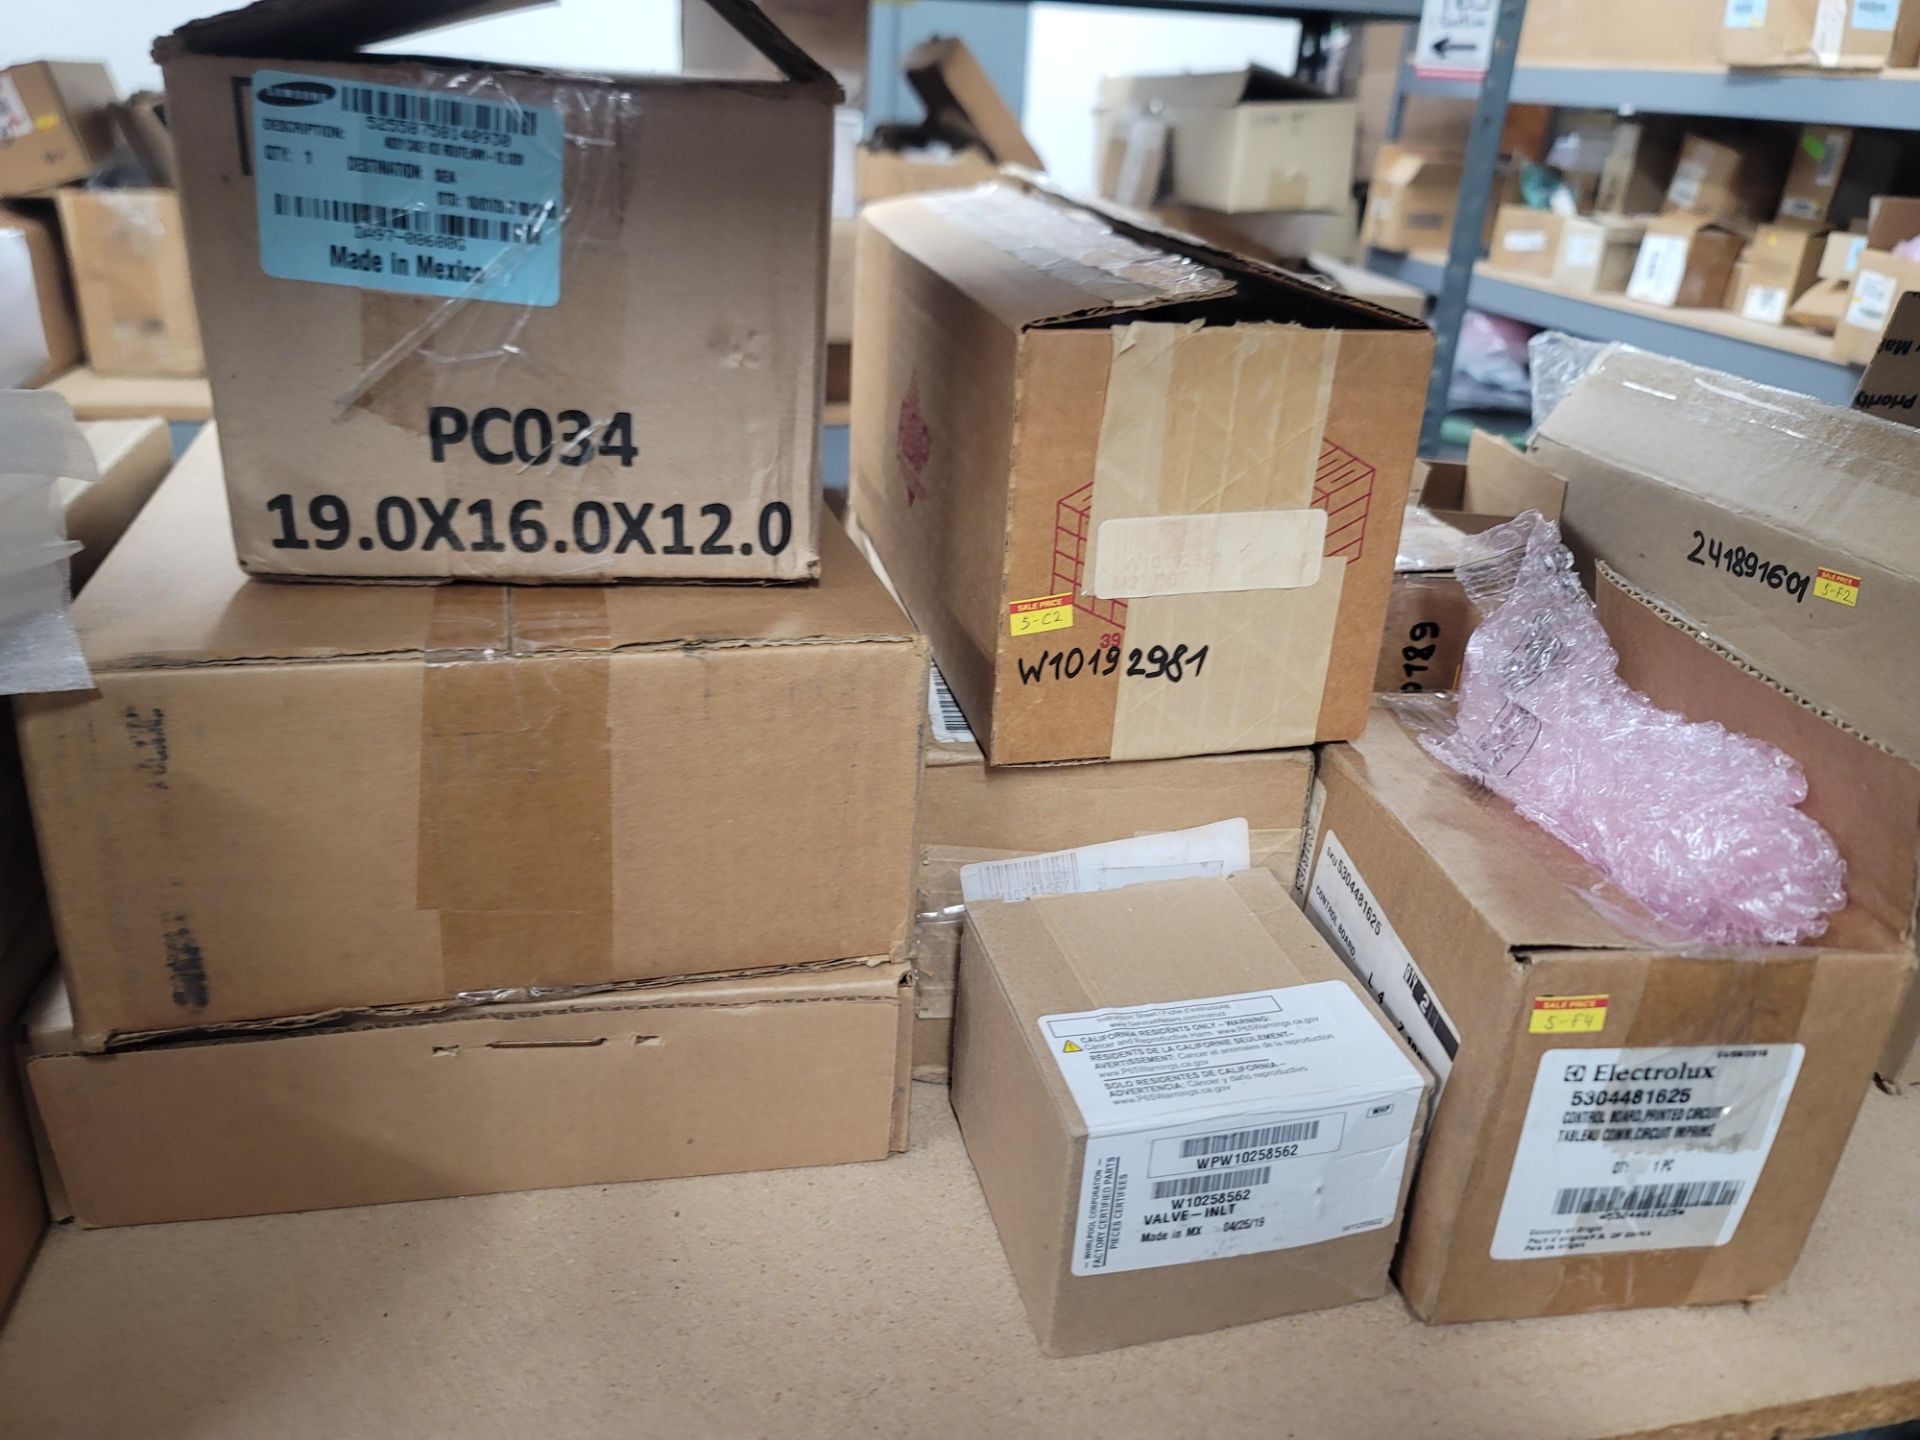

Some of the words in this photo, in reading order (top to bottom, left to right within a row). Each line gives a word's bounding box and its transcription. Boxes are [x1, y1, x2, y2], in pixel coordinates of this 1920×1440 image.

[330, 244, 383, 273] Made
[390, 252, 409, 276] in
[416, 254, 484, 284] Mexico
[428, 407, 638, 466] PC034
[266, 493, 792, 556] 19.0X16.0X12.0
[1687, 530, 1811, 603] 241891601
[1017, 602, 1038, 612] SALE
[1040, 599, 1063, 609] PRICE
[1100, 632, 1121, 649] 39
[1018, 644, 1209, 685] W10192981
[1315, 885, 1338, 926] CONTROL
[1337, 859, 1382, 936] 5304481625
[1420, 993, 1430, 1014] 2
[1081, 1031, 1137, 1044] CALIFORNIA
[1138, 1025, 1190, 1037] RESIDENTS
[1194, 1021, 1215, 1032] ONLY
[1226, 1016, 1271, 1027] WARNING:
[1089, 1048, 1144, 1061] RESIDENTS
[1146, 1046, 1160, 1055] DE
[1162, 1045, 1174, 1054] LA
[1175, 1039, 1232, 1052] CALIFORNIE
[1095, 1054, 1176, 1070] AVERTISSEMENT:
[1136, 1072, 1199, 1085] RESIDENTES
[1201, 1069, 1215, 1078] DE
[1218, 1062, 1278, 1075] CALIFORNIA
[1594, 1062, 1716, 1082] Electrolux
[1109, 1083, 1183, 1098] ADVERTENCIA:
[1571, 1088, 1693, 1106] 5304481625
[1562, 1110, 1605, 1124] CONTROL
[1685, 1106, 1723, 1121] CIRCUIT
[1557, 1129, 1600, 1142] TABLEAU
[1197, 1145, 1298, 1169] WPW10258562
[1104, 1156, 1116, 1186] PARTS
[1089, 1169, 1102, 1219] CORPORATION
[1172, 1189, 1251, 1210] W10258562
[1098, 1186, 1112, 1231] CERTIFIED
[1084, 1221, 1096, 1260] WHIRLPOOL
[1141, 1231, 1167, 1243] Made
[1171, 1230, 1181, 1239] in
[1186, 1226, 1203, 1237] MX
[1093, 1232, 1105, 1268] FACTORY
